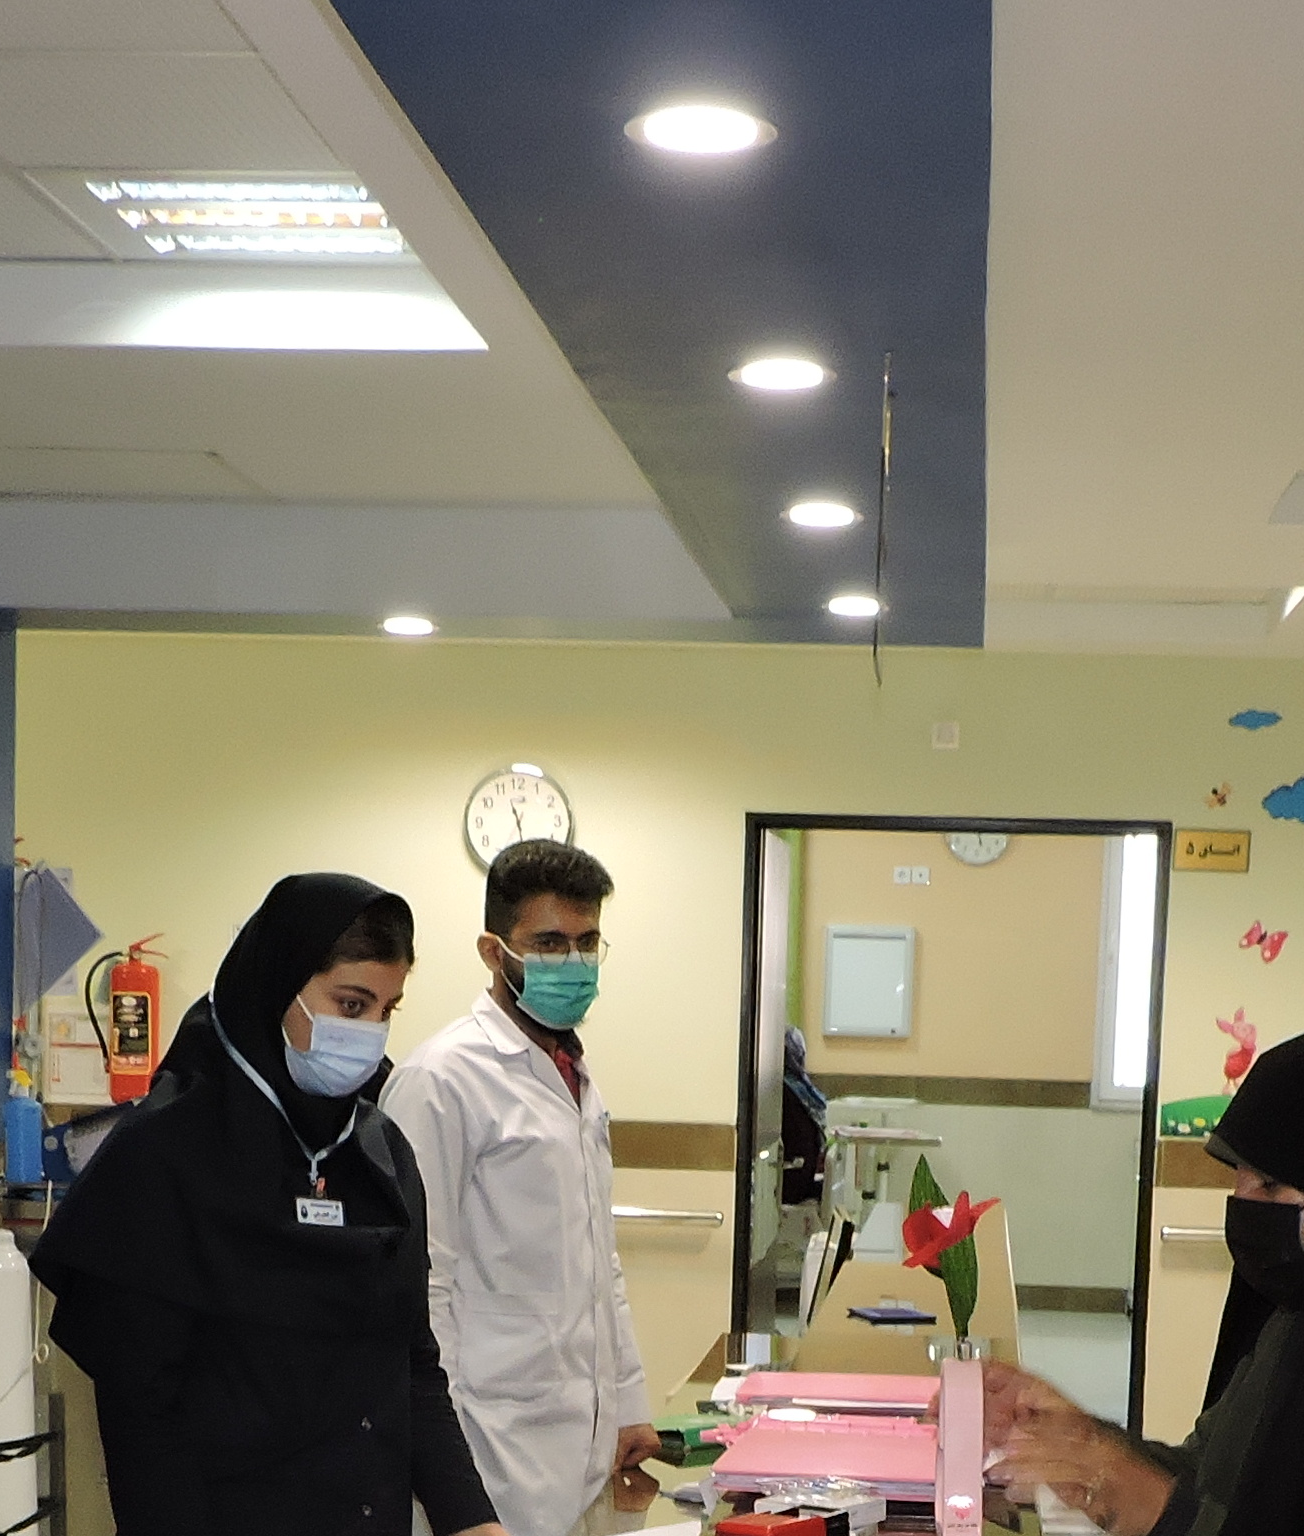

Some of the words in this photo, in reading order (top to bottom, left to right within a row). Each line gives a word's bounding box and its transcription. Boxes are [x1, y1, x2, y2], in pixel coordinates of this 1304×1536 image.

[511, 777, 525, 790] 12
[475, 816, 483, 829] 9
[554, 814, 562, 828] 3
[482, 834, 490, 847] 8
